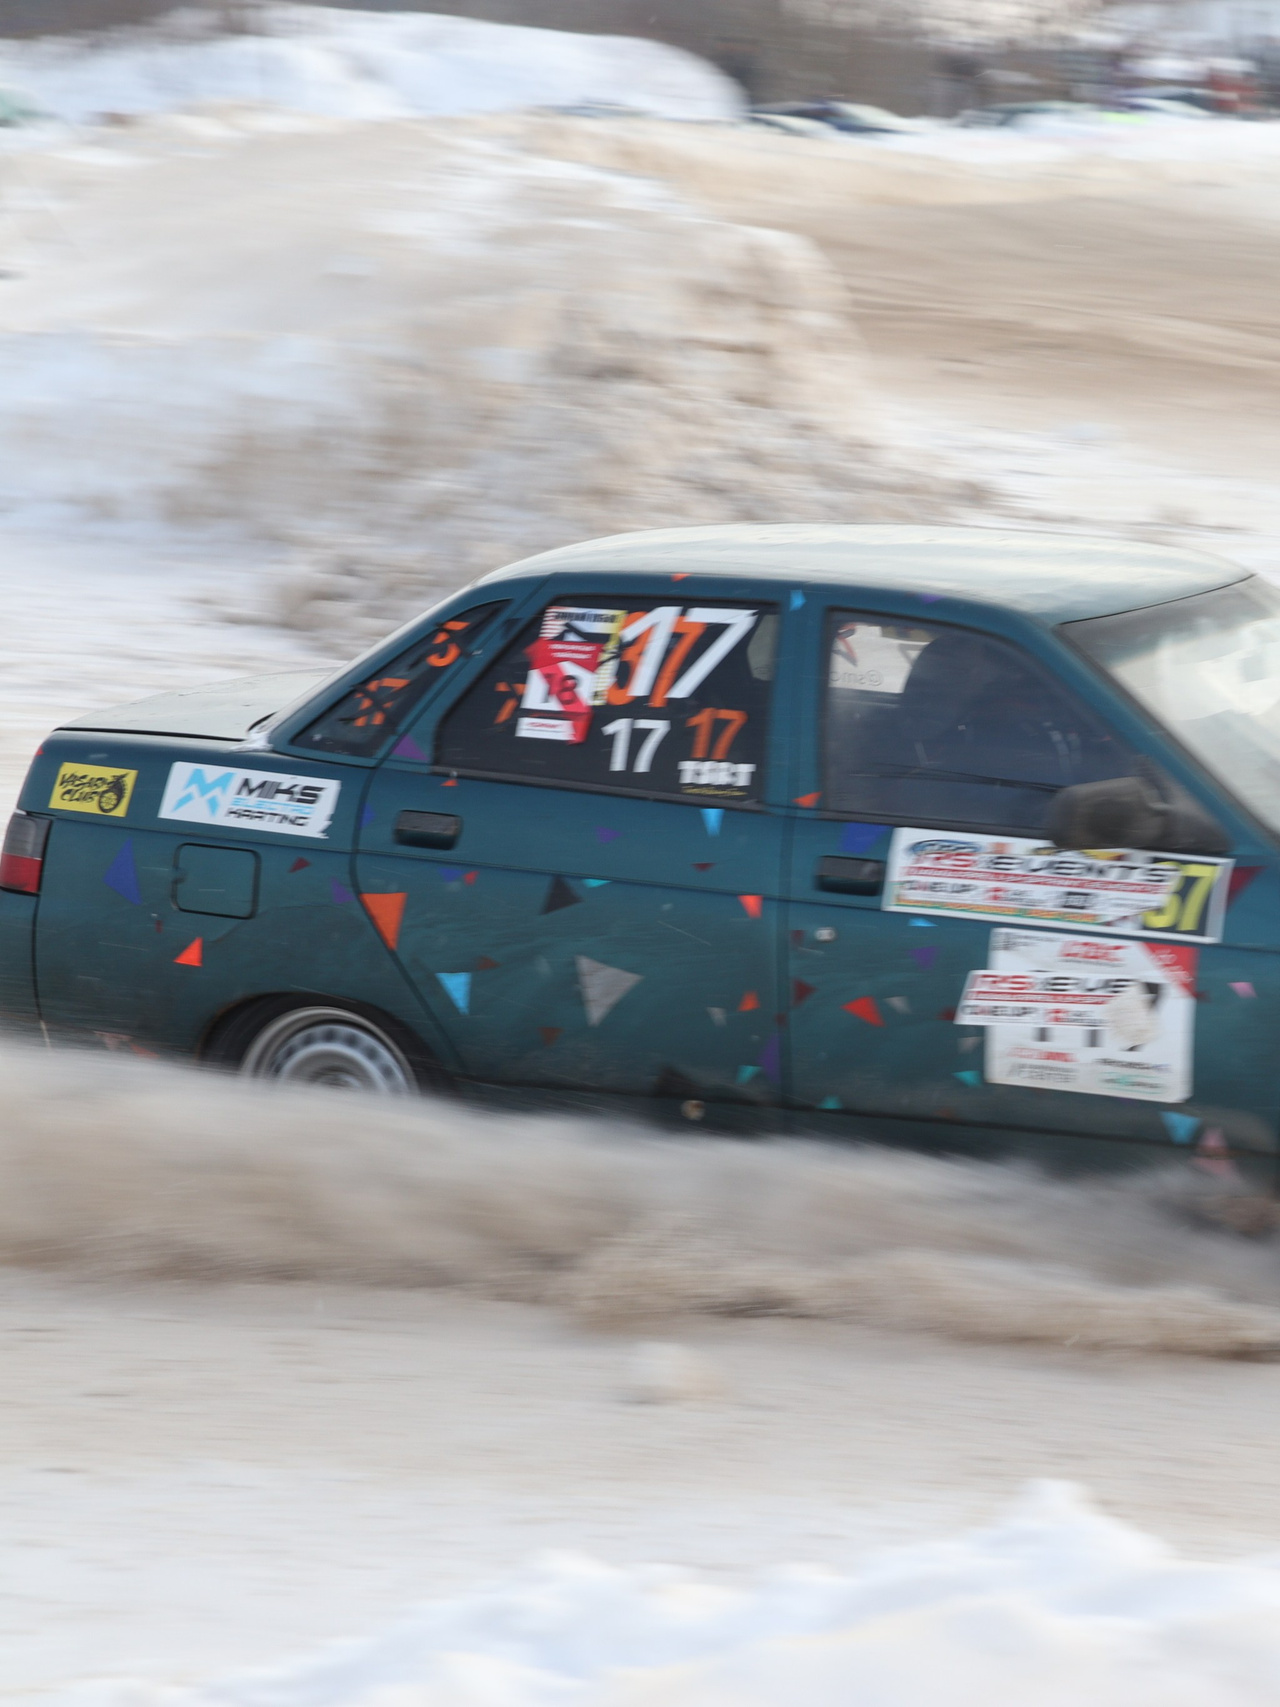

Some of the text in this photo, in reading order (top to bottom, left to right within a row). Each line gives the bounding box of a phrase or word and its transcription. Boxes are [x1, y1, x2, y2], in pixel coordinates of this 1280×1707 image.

[619, 606, 759, 698] 17
[601, 718, 671, 773] 17
[685, 707, 748, 760] 17
[236, 777, 326, 805] MIKS
